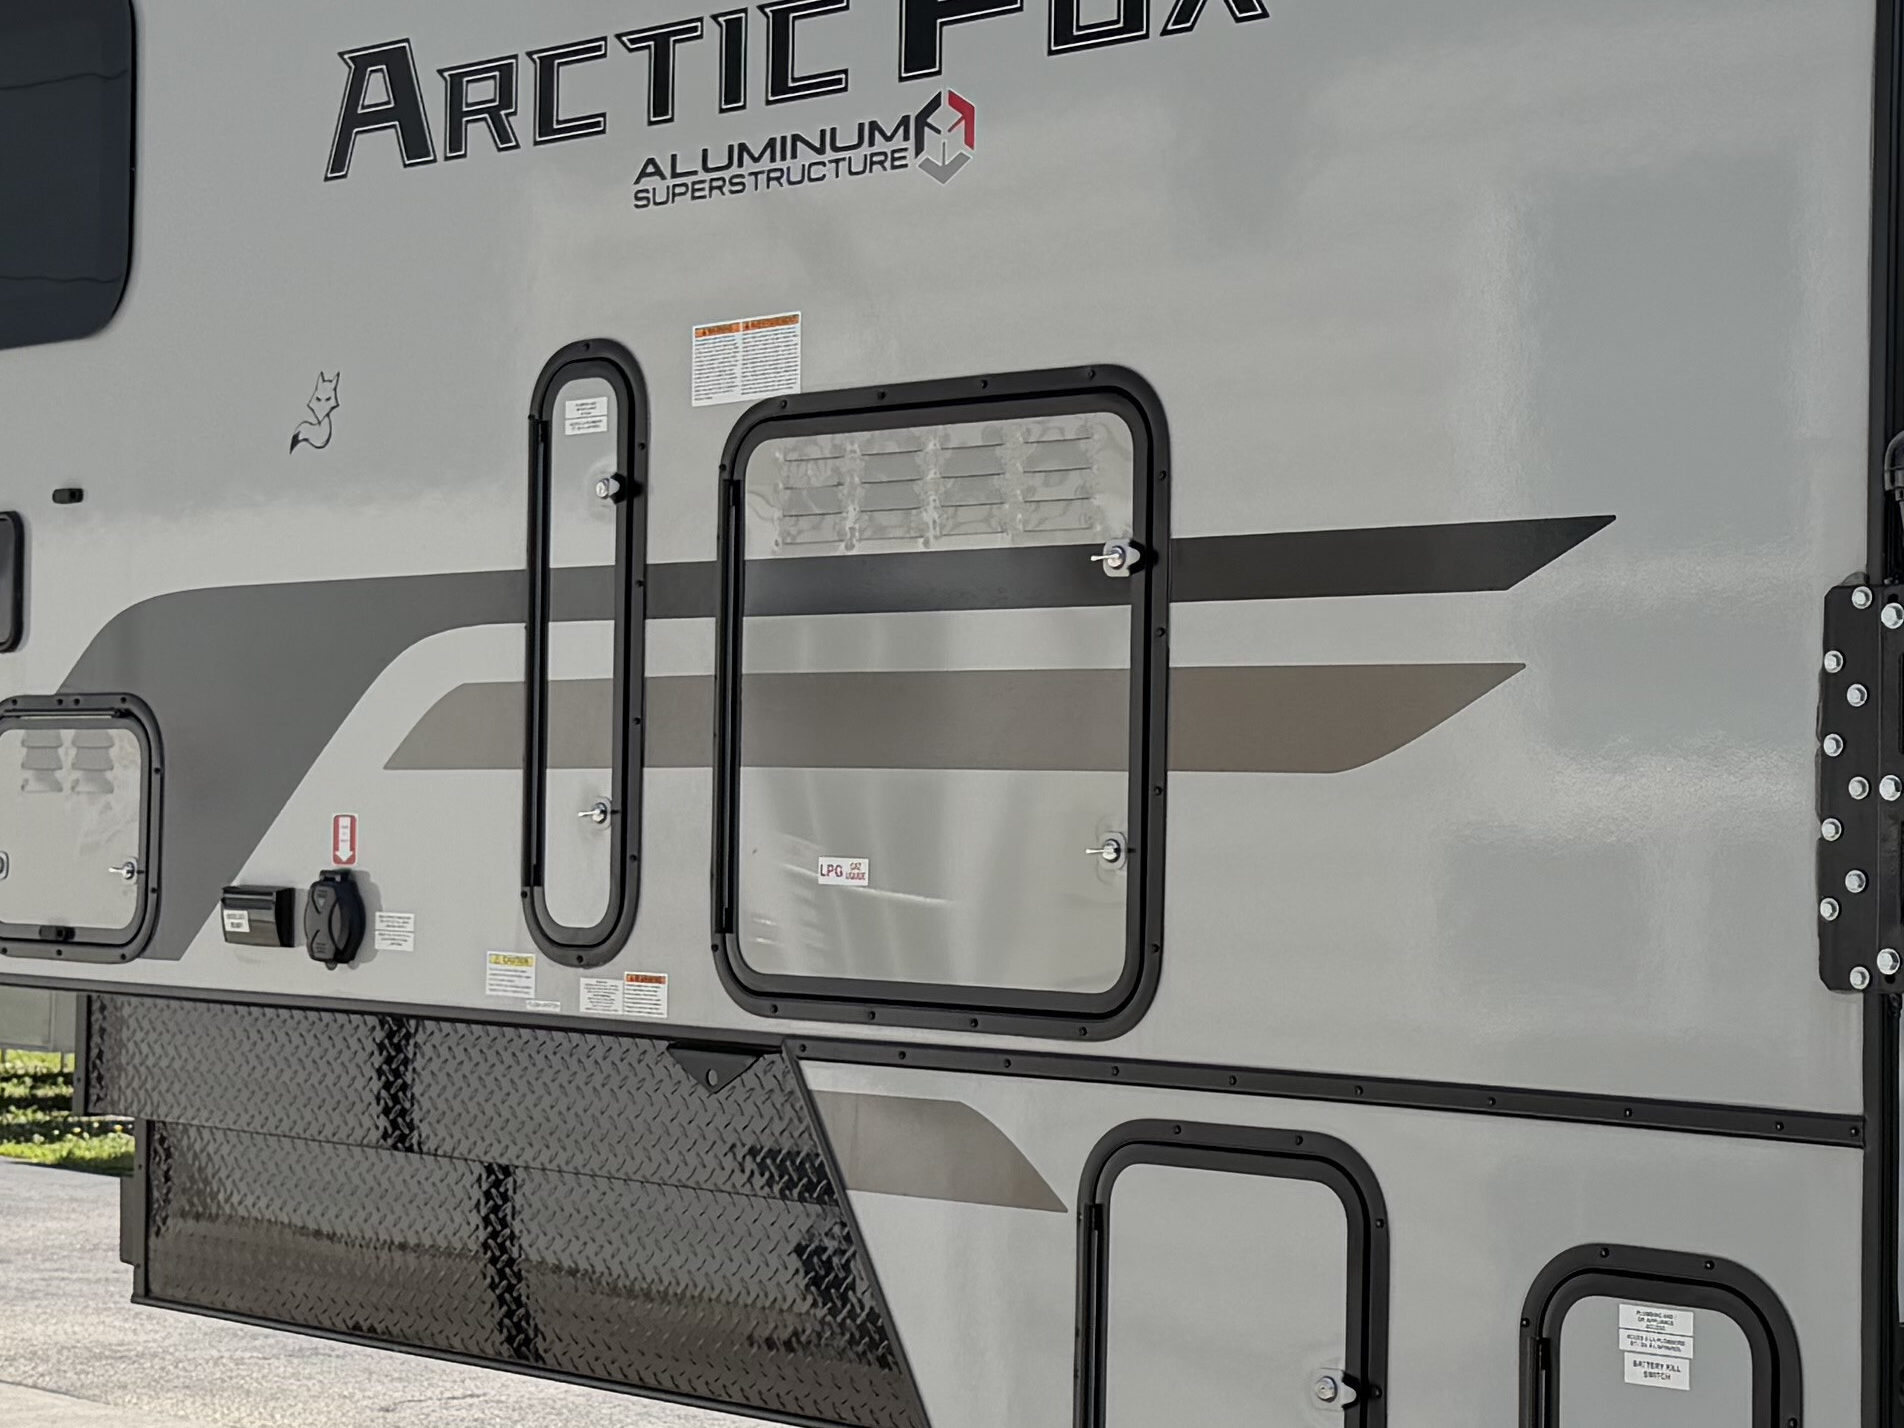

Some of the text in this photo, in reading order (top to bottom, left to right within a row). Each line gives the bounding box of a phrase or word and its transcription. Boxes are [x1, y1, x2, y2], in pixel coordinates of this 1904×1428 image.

[633, 114, 912, 185] ALUMINUM
[633, 147, 910, 209] SUPERSTRUCTURE
[820, 863, 843, 878] LPG
